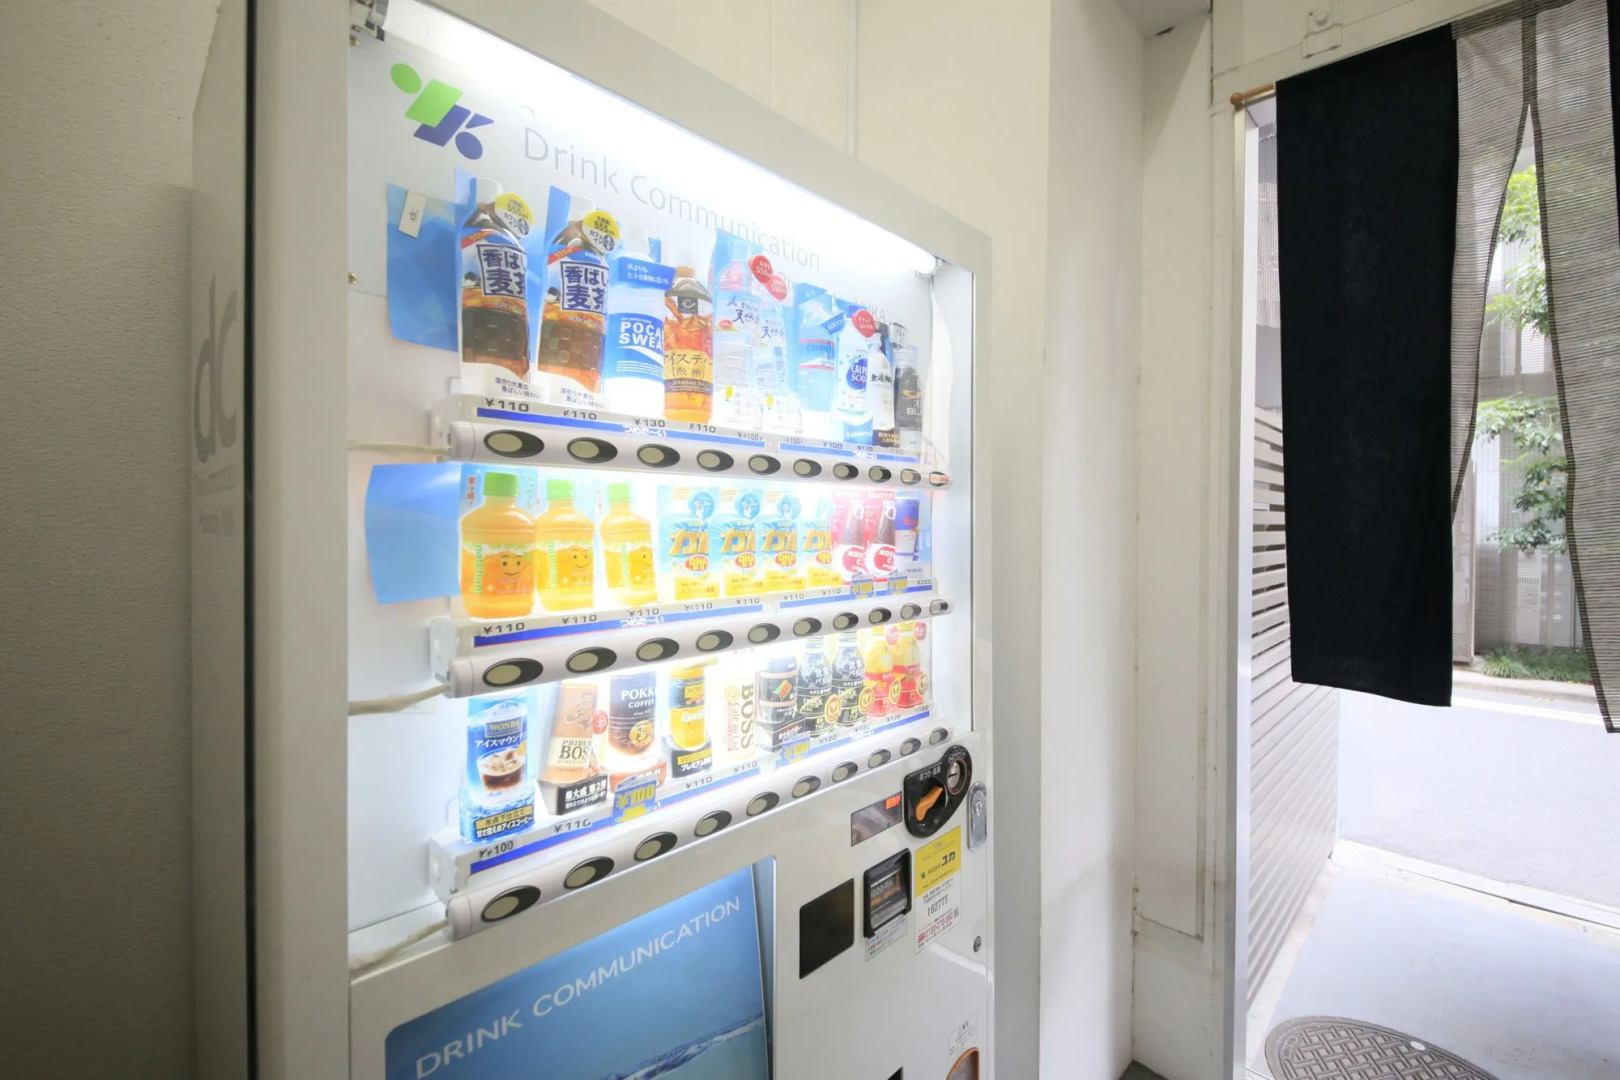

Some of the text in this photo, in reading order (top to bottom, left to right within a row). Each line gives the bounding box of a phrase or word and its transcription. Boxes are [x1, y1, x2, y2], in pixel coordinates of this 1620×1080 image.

[523, 126, 821, 272] Drink Communication
[620, 321, 664, 339] POCA
[618, 332, 664, 350] SWEA
[485, 397, 530, 412] ¥110
[563, 409, 598, 421] ¥110
[633, 418, 666, 428] ¥130
[689, 423, 717, 433] ¥110
[783, 593, 805, 601] ¥110
[822, 588, 842, 596] ¥110
[735, 597, 760, 606] ¥110
[560, 613, 598, 625] ¥110
[628, 607, 660, 617] ¥110
[483, 621, 526, 635] ¥110
[740, 682, 755, 750] BOSS
[819, 734, 838, 744] ¥120
[733, 760, 758, 774] ¥110
[685, 775, 714, 789] ¥110
[927, 894, 949, 916] 162777
[415, 895, 742, 1078] DRINK COMMUNICATION
